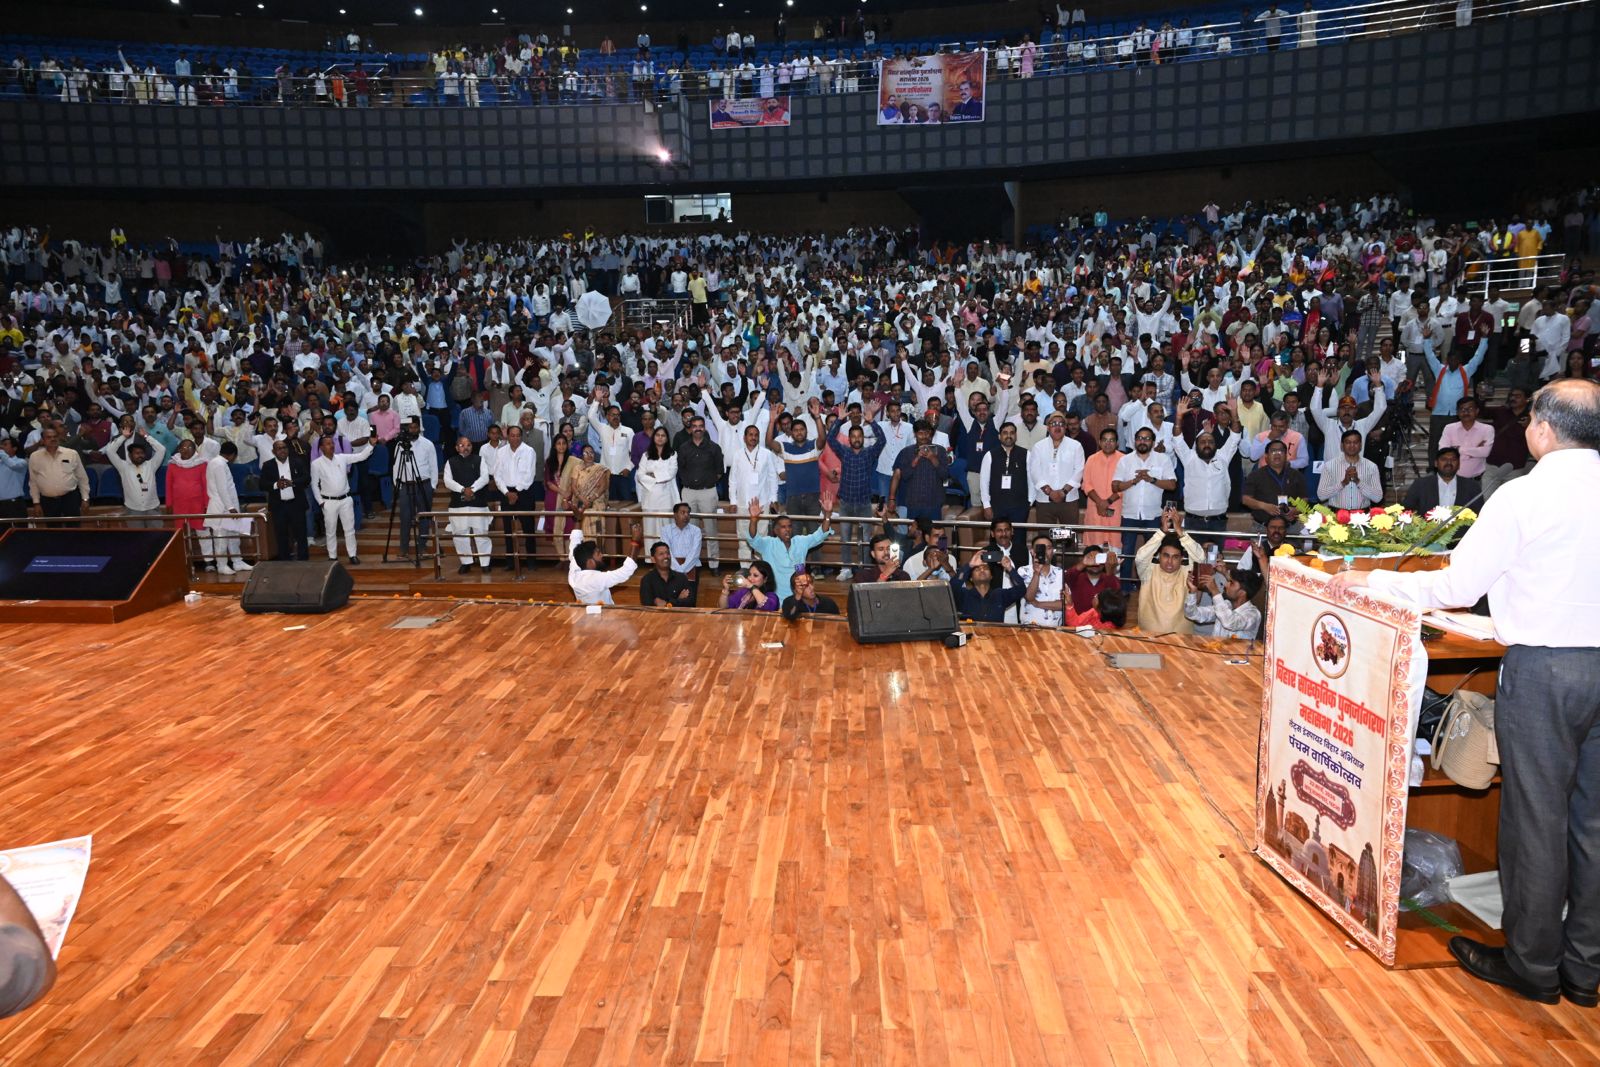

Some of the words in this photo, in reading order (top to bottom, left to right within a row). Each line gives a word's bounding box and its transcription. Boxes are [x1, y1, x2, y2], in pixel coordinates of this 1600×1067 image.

[1276, 658, 1296, 688] बिहार
[1298, 672, 1337, 708] सांस्कृतिक
[1338, 694, 1386, 738] पुनर्जागरण
[1299, 703, 1332, 735] महासभा
[1333, 722, 1354, 747] 2026
[1289, 734, 1311, 756] पंचम
[1311, 748, 1362, 789] वार्षिकोत्सव
[1323, 738, 1340, 755] बिहार
[1340, 750, 1365, 771] अभियान
